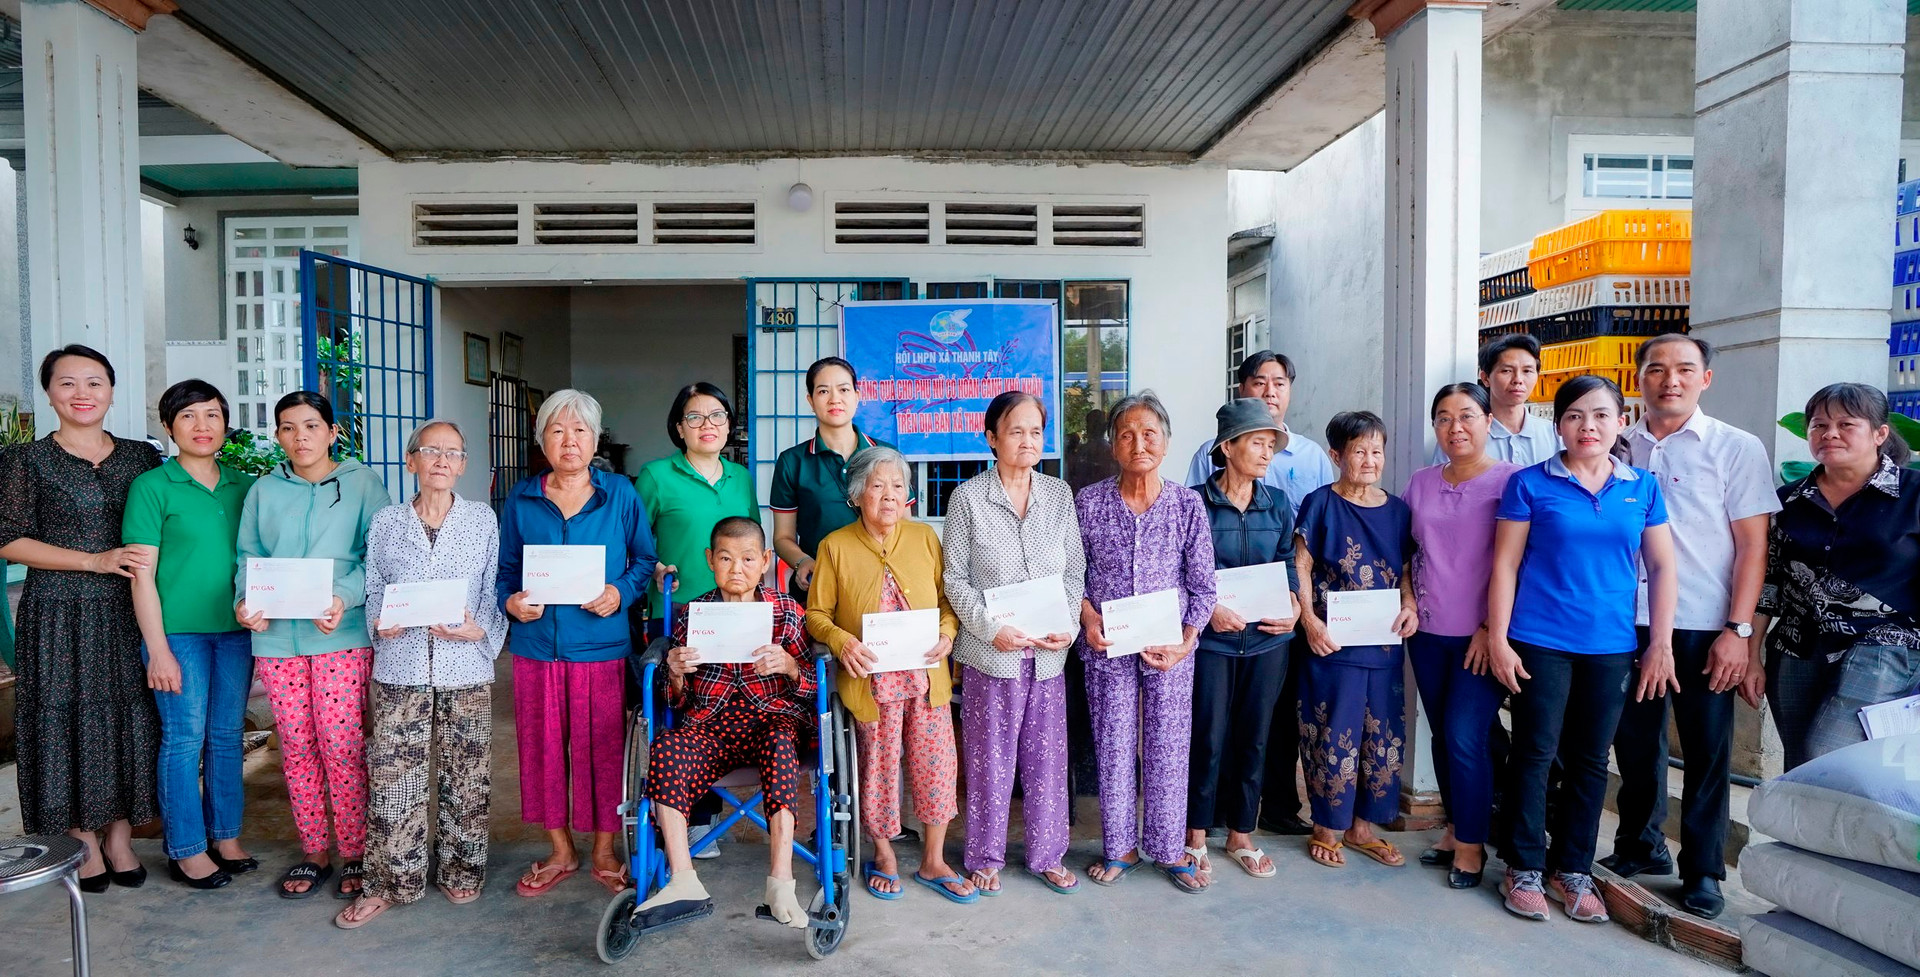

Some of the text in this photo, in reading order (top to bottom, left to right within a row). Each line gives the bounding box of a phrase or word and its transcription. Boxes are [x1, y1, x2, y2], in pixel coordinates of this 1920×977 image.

[767, 312, 794, 326] 480
[895, 350, 910, 366] HỘI
[913, 352, 936, 364] LHPN
[952, 351, 981, 365] THẠNH
[983, 349, 999, 363] TÂY
[896, 379, 913, 400] CHO
[915, 379, 931, 404] PHỤ
[964, 411, 986, 437] THẠN
[1002, 611, 1016, 619] GAS
[341, 865, 364, 877] Chlo
